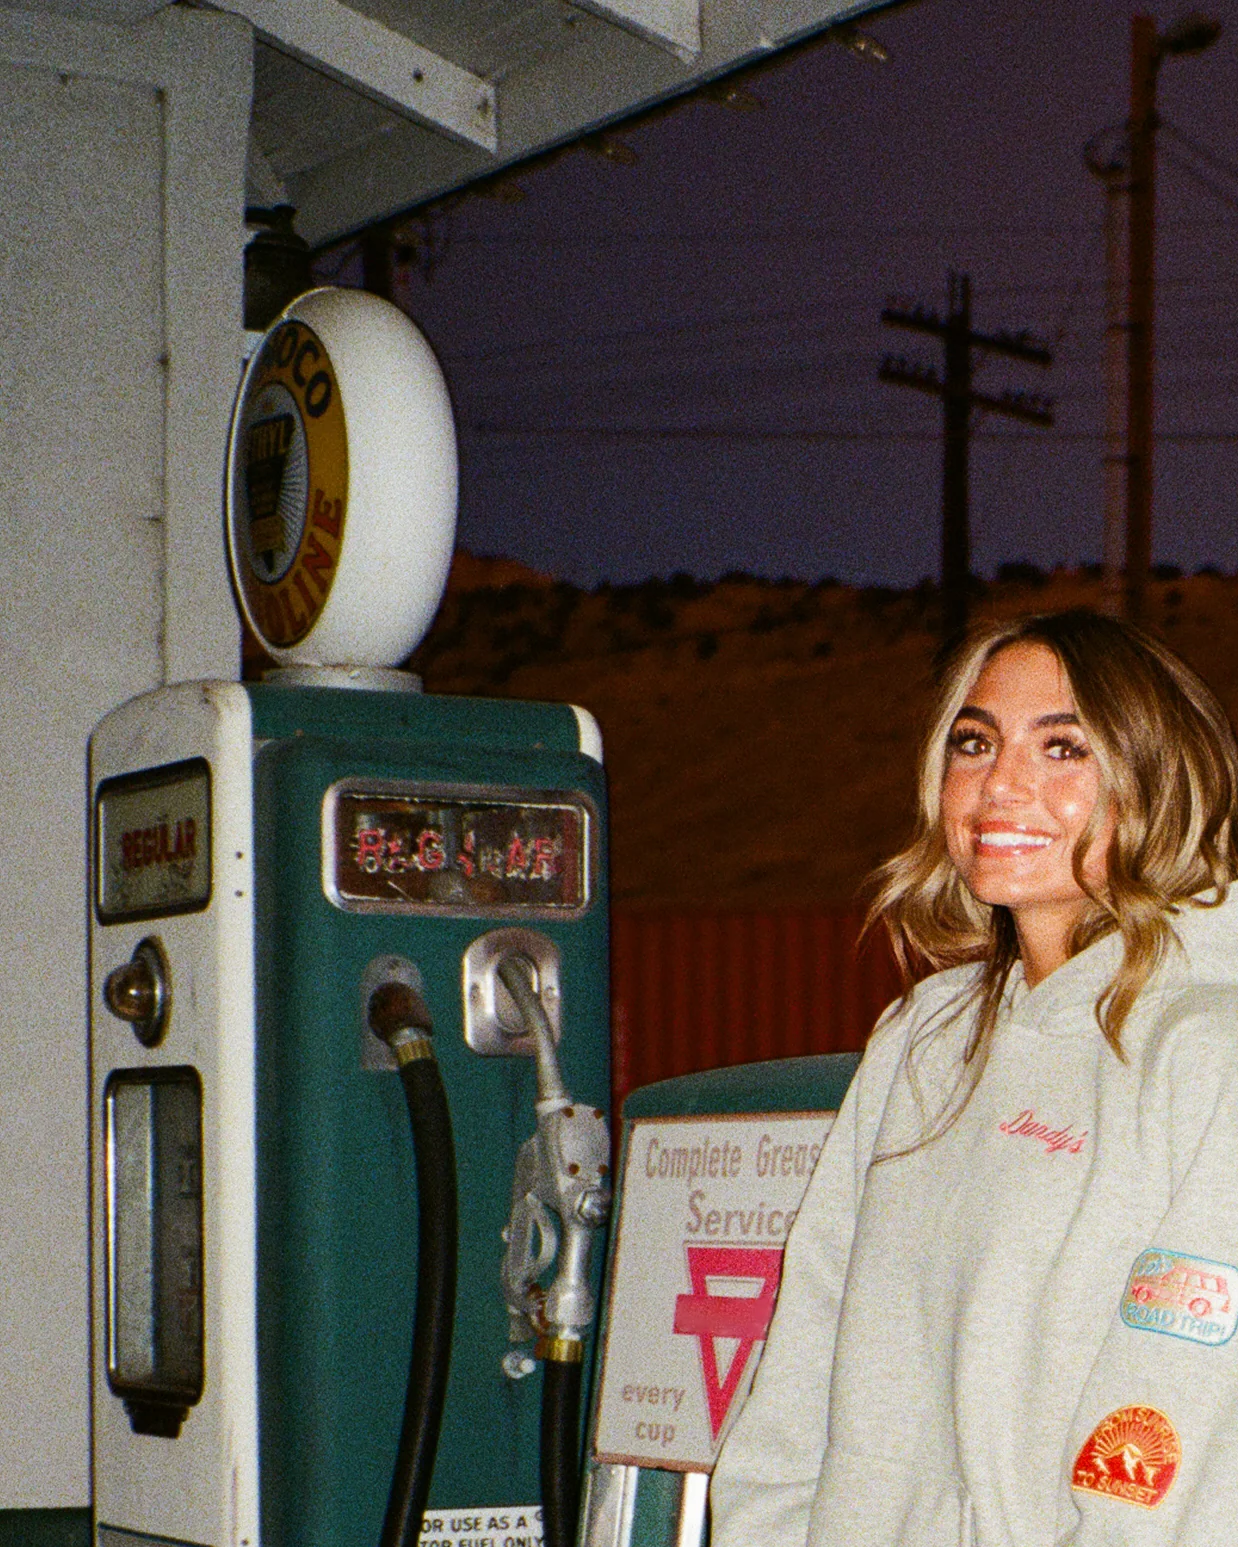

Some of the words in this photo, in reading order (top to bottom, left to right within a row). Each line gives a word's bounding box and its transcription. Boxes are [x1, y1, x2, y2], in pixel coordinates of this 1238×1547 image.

[999, 1109, 1088, 1153] Dandy's
[645, 1136, 743, 1187] Complete
[1127, 1302, 1175, 1327] ROAD
[622, 1382, 686, 1412] every
[635, 1420, 676, 1447] cup
[421, 1519, 444, 1533] OR
[451, 1516, 482, 1531] USE
[487, 1516, 511, 1530] AS
[516, 1515, 528, 1529] A
